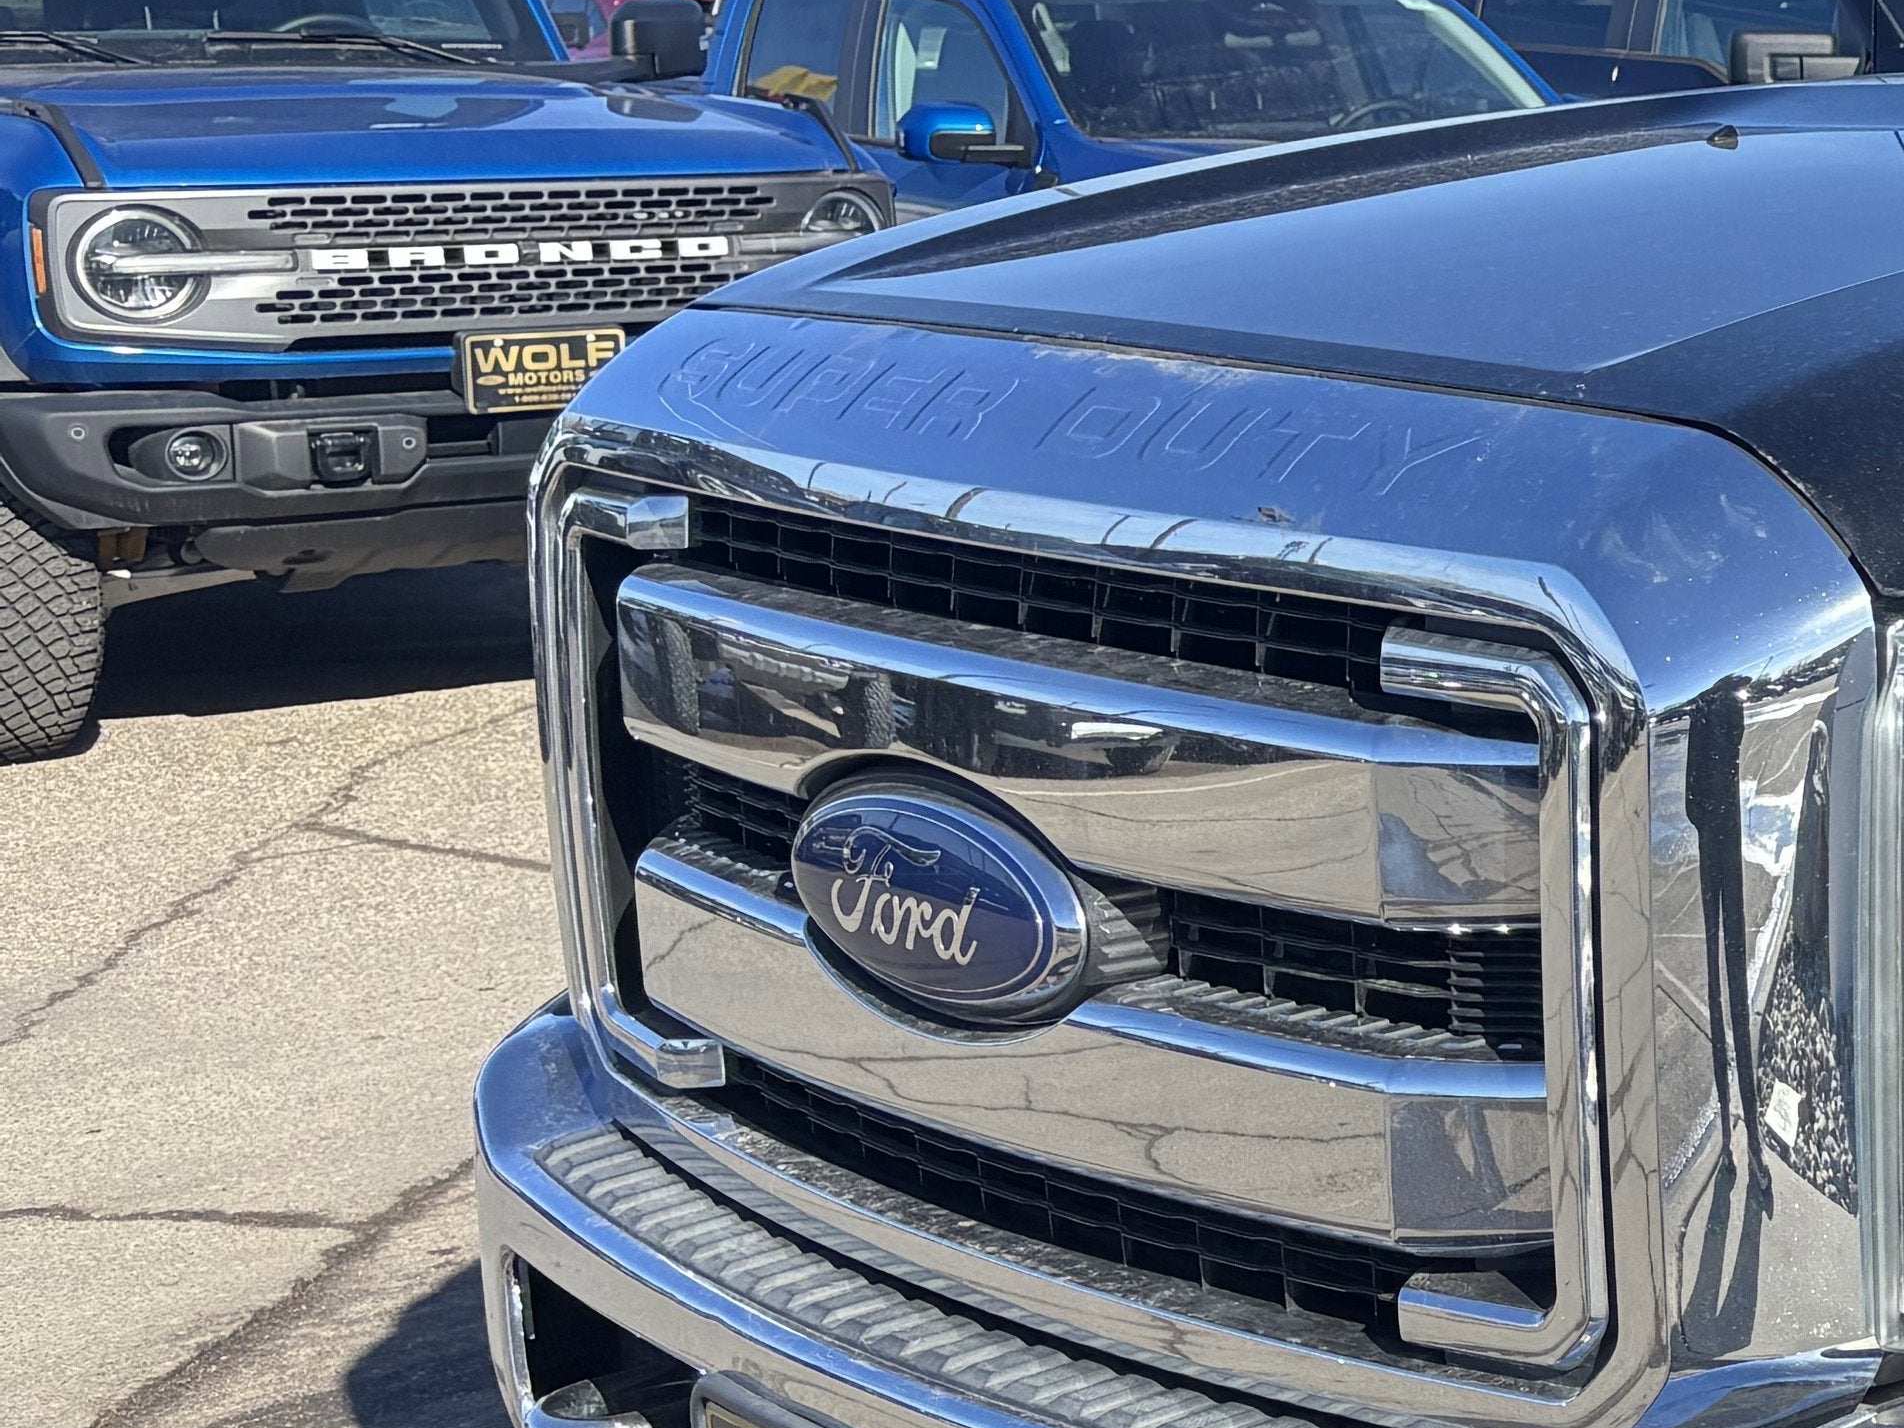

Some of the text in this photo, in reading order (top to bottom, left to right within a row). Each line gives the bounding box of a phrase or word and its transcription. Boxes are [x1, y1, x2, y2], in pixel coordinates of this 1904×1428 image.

[312, 236, 729, 270] BRONCO
[474, 341, 615, 372] WOLF
[508, 369, 585, 386] MOTORS
[657, 337, 1488, 495] SUPER DUTY
[831, 825, 981, 966] Ford
